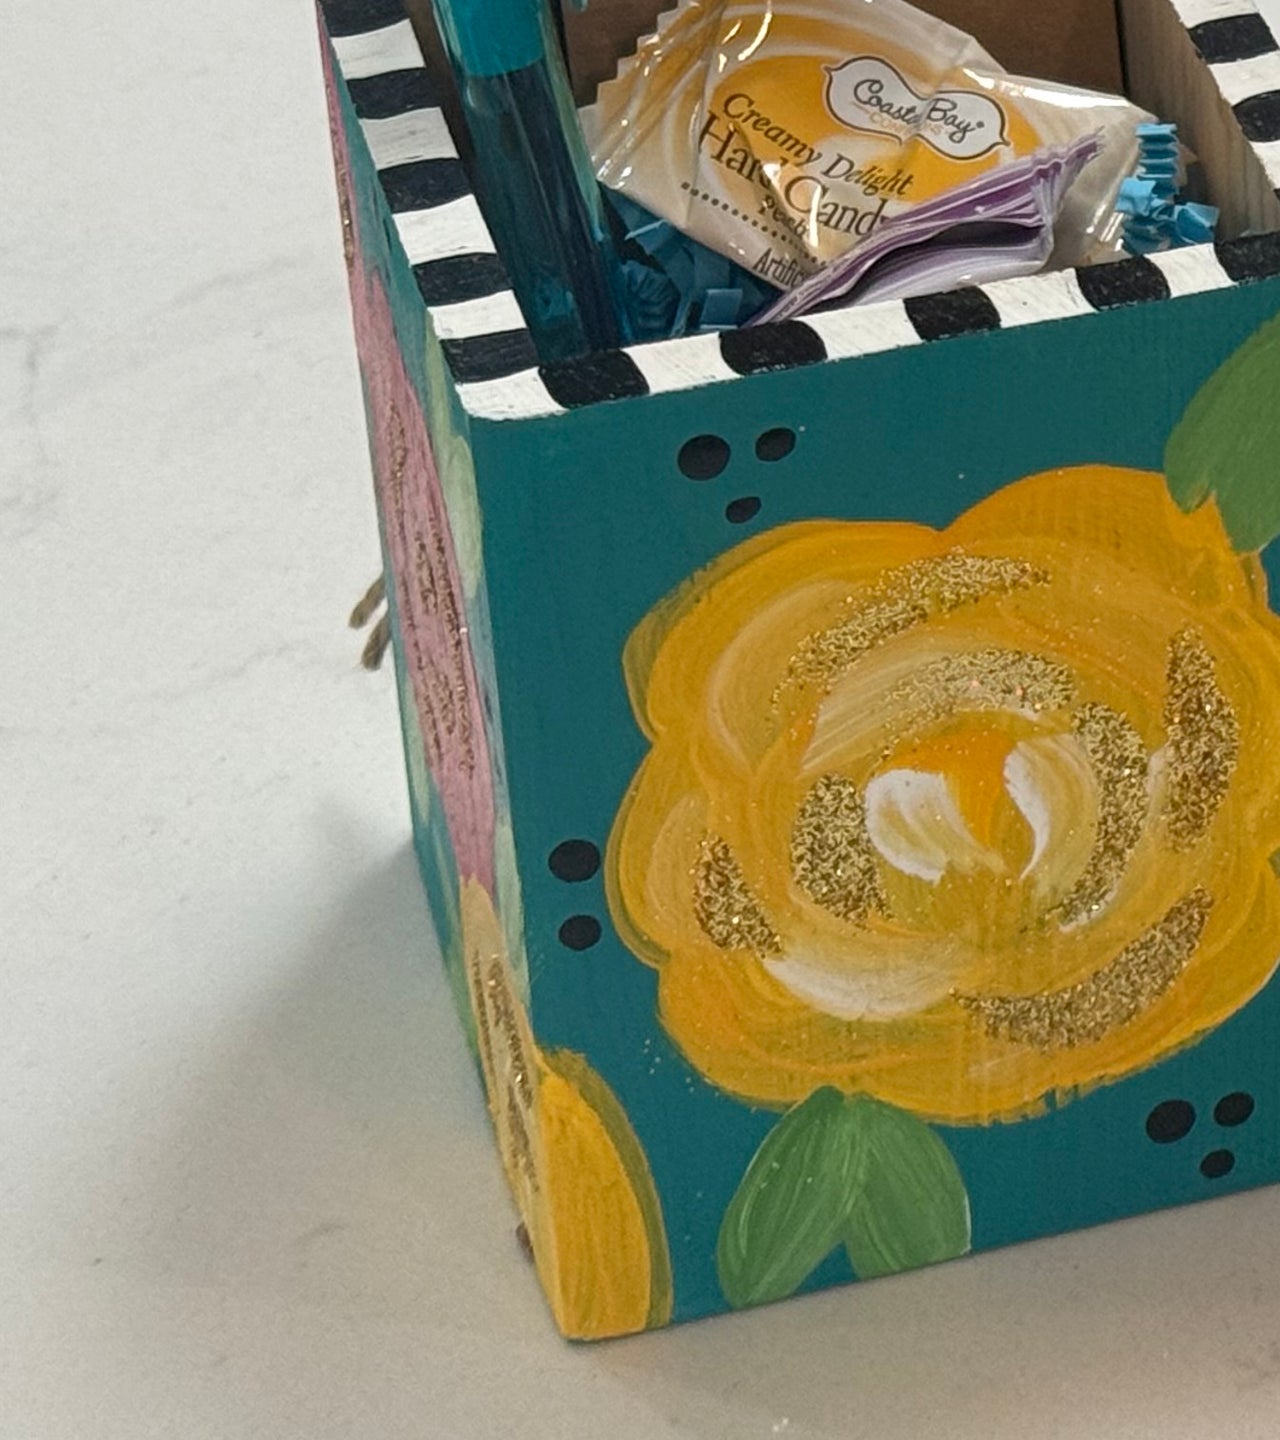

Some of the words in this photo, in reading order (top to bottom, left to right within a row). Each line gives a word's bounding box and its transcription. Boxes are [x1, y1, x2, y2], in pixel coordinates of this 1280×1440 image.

[723, 93, 823, 168] Creamy
[820, 153, 914, 196] Delight
[784, 175, 890, 237] Cand
